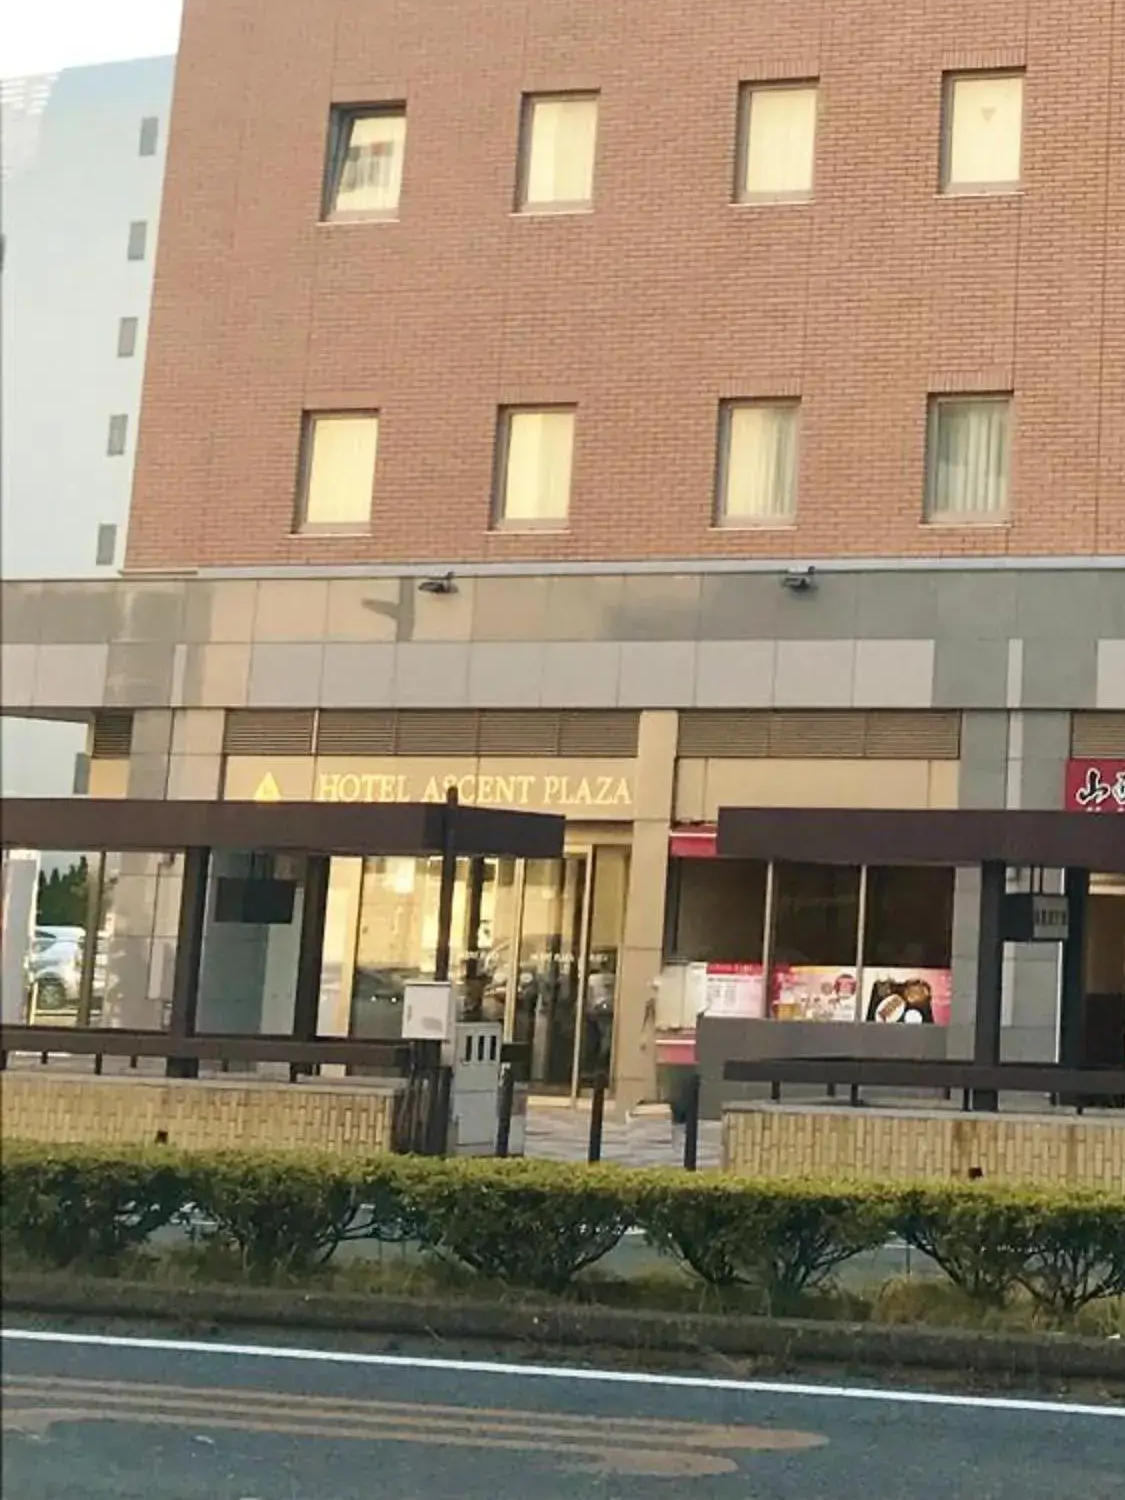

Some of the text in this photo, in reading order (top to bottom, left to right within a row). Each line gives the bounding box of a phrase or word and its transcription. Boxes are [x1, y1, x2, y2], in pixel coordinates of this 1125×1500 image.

[318, 773, 632, 805] HOTEL ASCENT PLAZA
